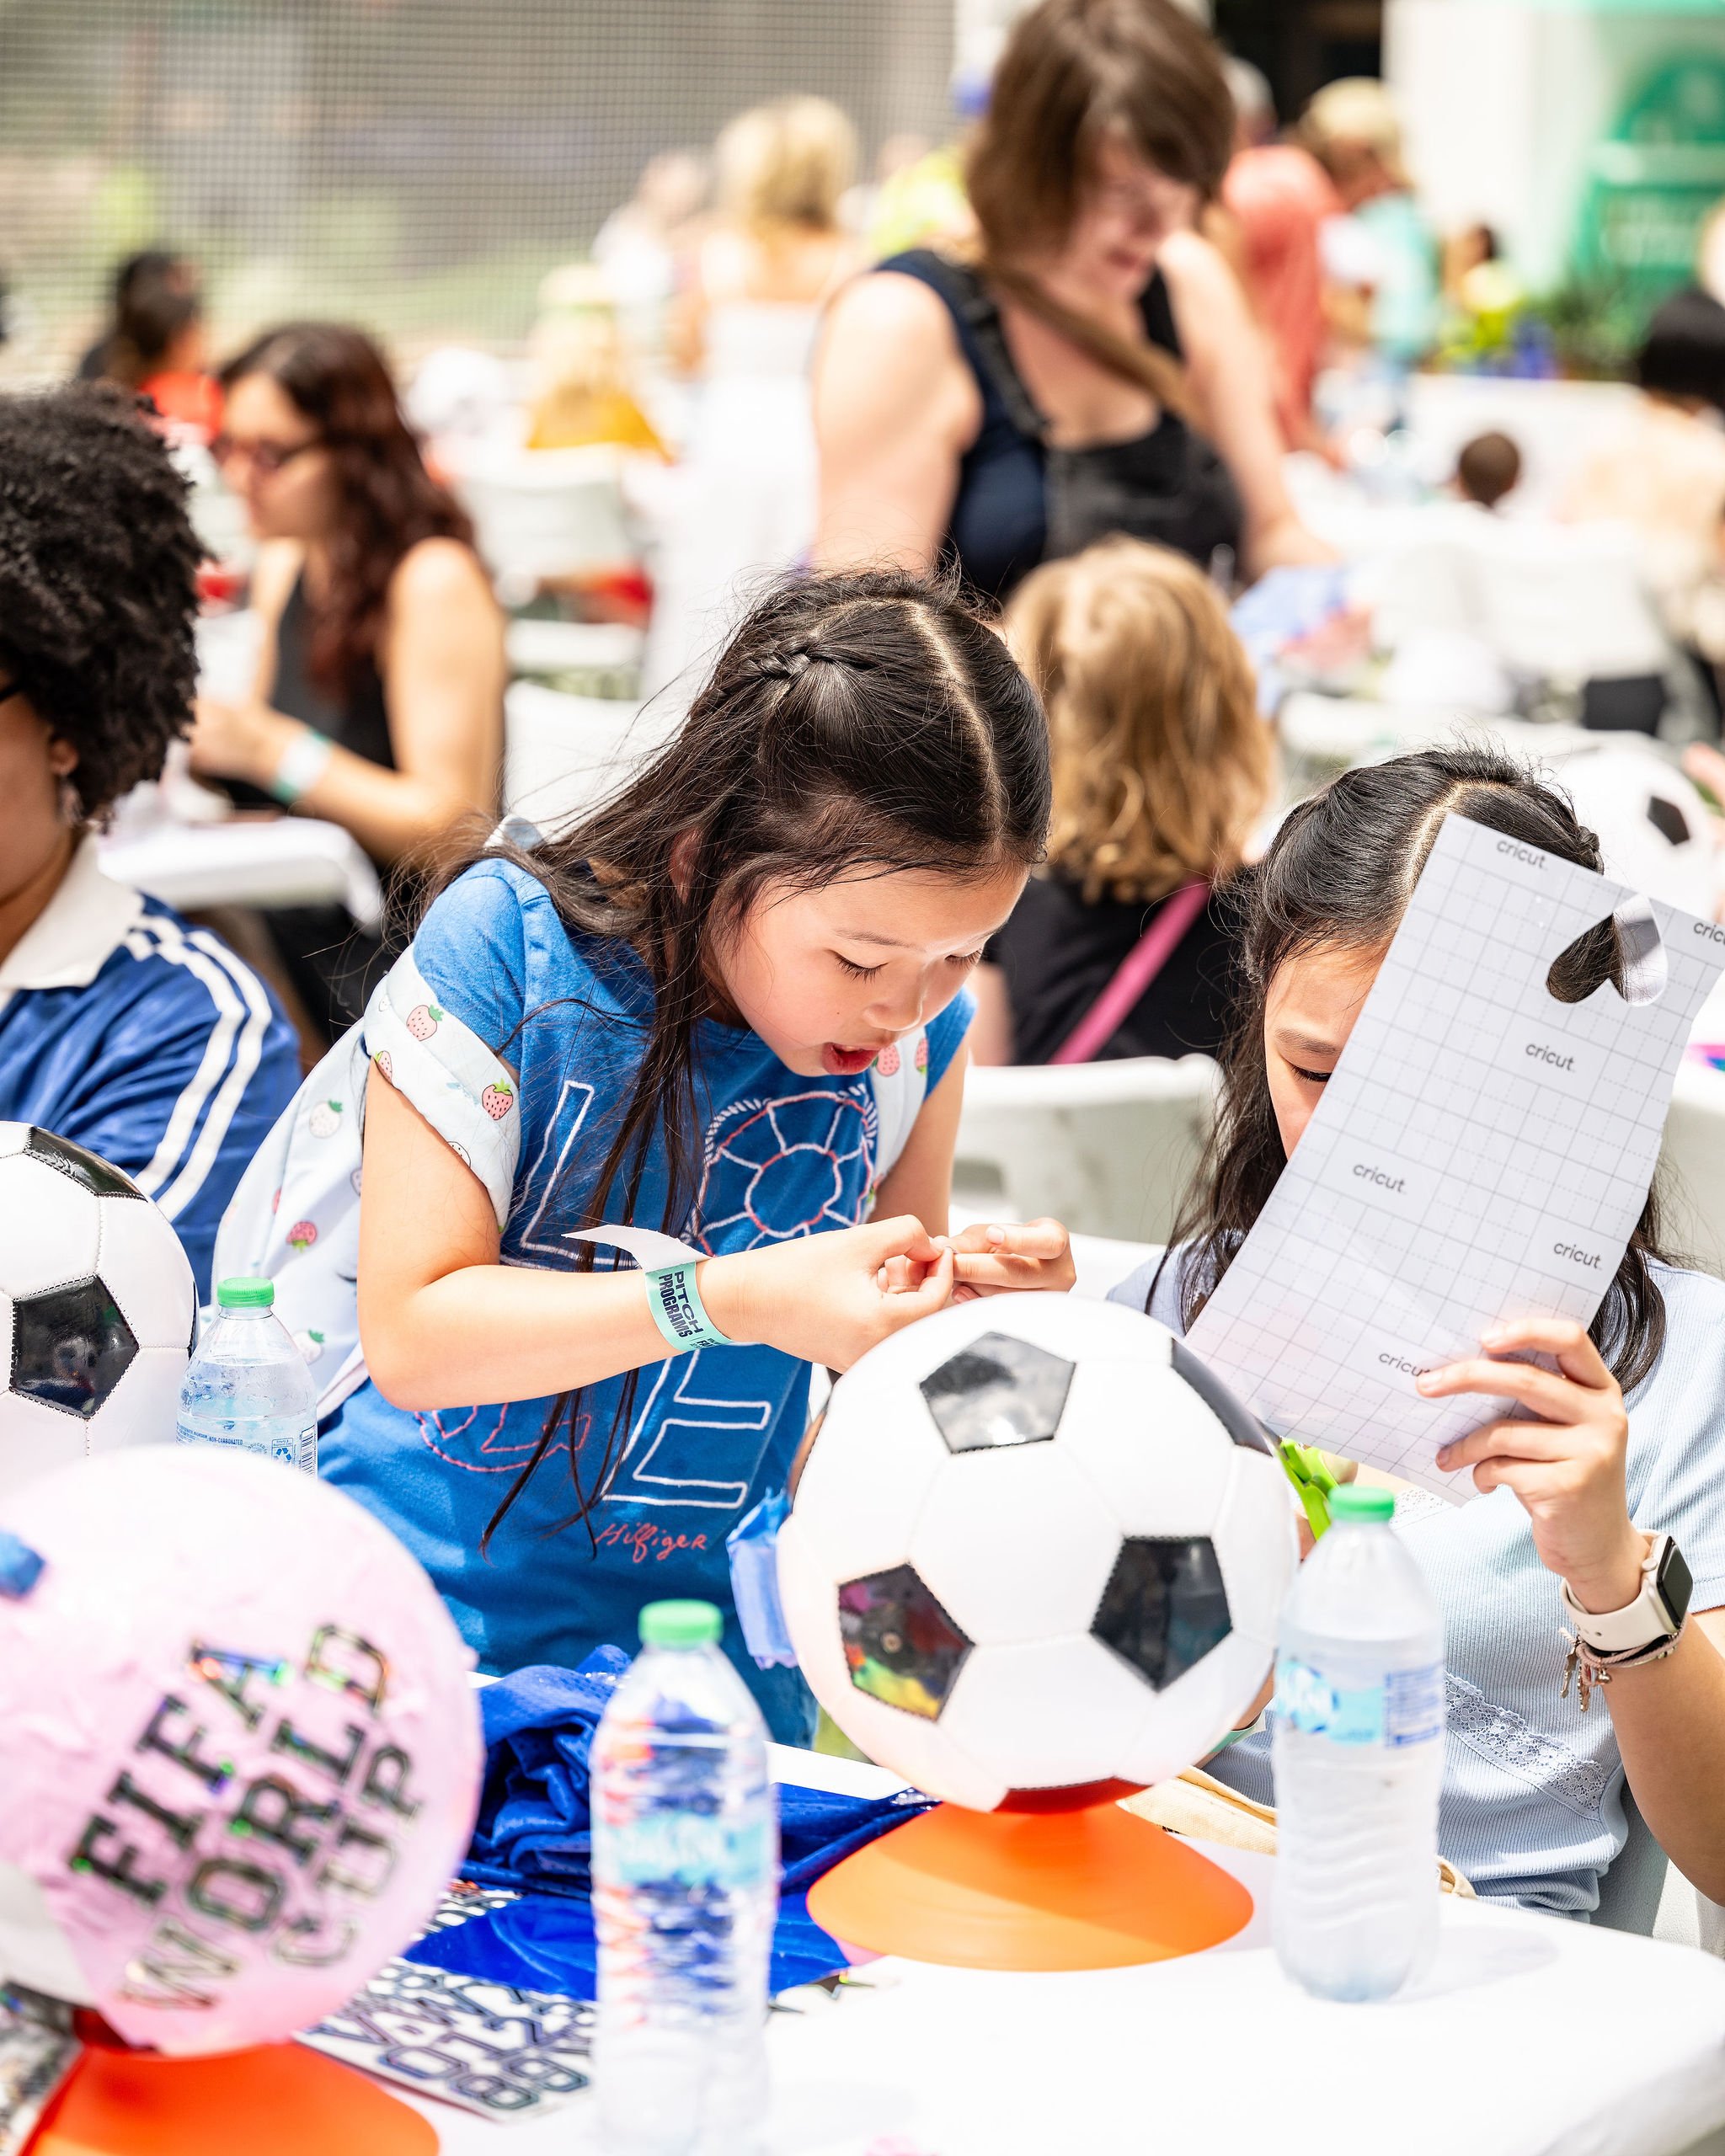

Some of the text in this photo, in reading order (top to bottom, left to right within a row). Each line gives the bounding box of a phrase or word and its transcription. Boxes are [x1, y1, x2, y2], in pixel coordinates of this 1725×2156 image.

[1496, 840, 1549, 871] cricut
[1693, 922, 1725, 945] cric
[1525, 1043, 1576, 1072] cricut
[1353, 1163, 1407, 1193] cricut
[1553, 1241, 1602, 1269] cricut
[659, 1273, 693, 1337] PROGRAMS
[675, 1271, 704, 1333] PITCH
[1379, 1353, 1430, 1377] cricu
[71, 1639, 286, 1908] FIFA
[119, 1624, 390, 2009] WORLD
